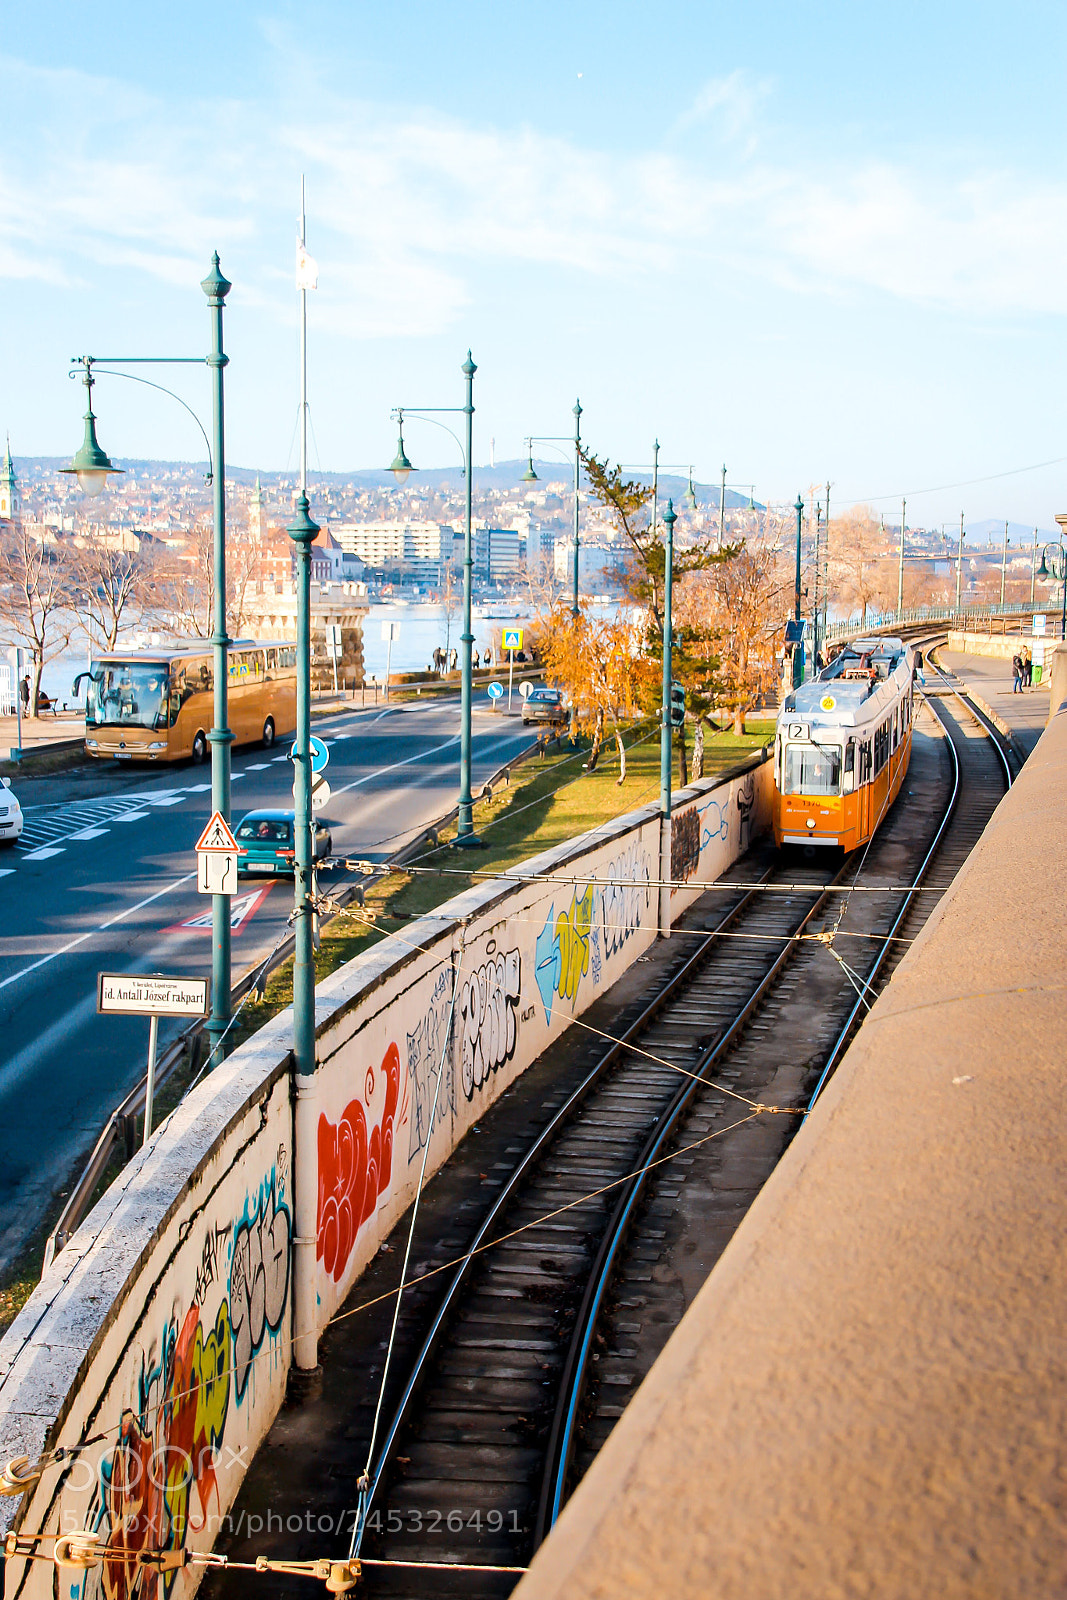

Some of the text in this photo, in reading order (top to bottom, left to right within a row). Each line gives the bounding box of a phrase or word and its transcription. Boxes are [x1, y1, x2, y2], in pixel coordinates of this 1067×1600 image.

[793, 725, 803, 738] 2
[104, 988, 204, 1005] id. Antall József rakpart
